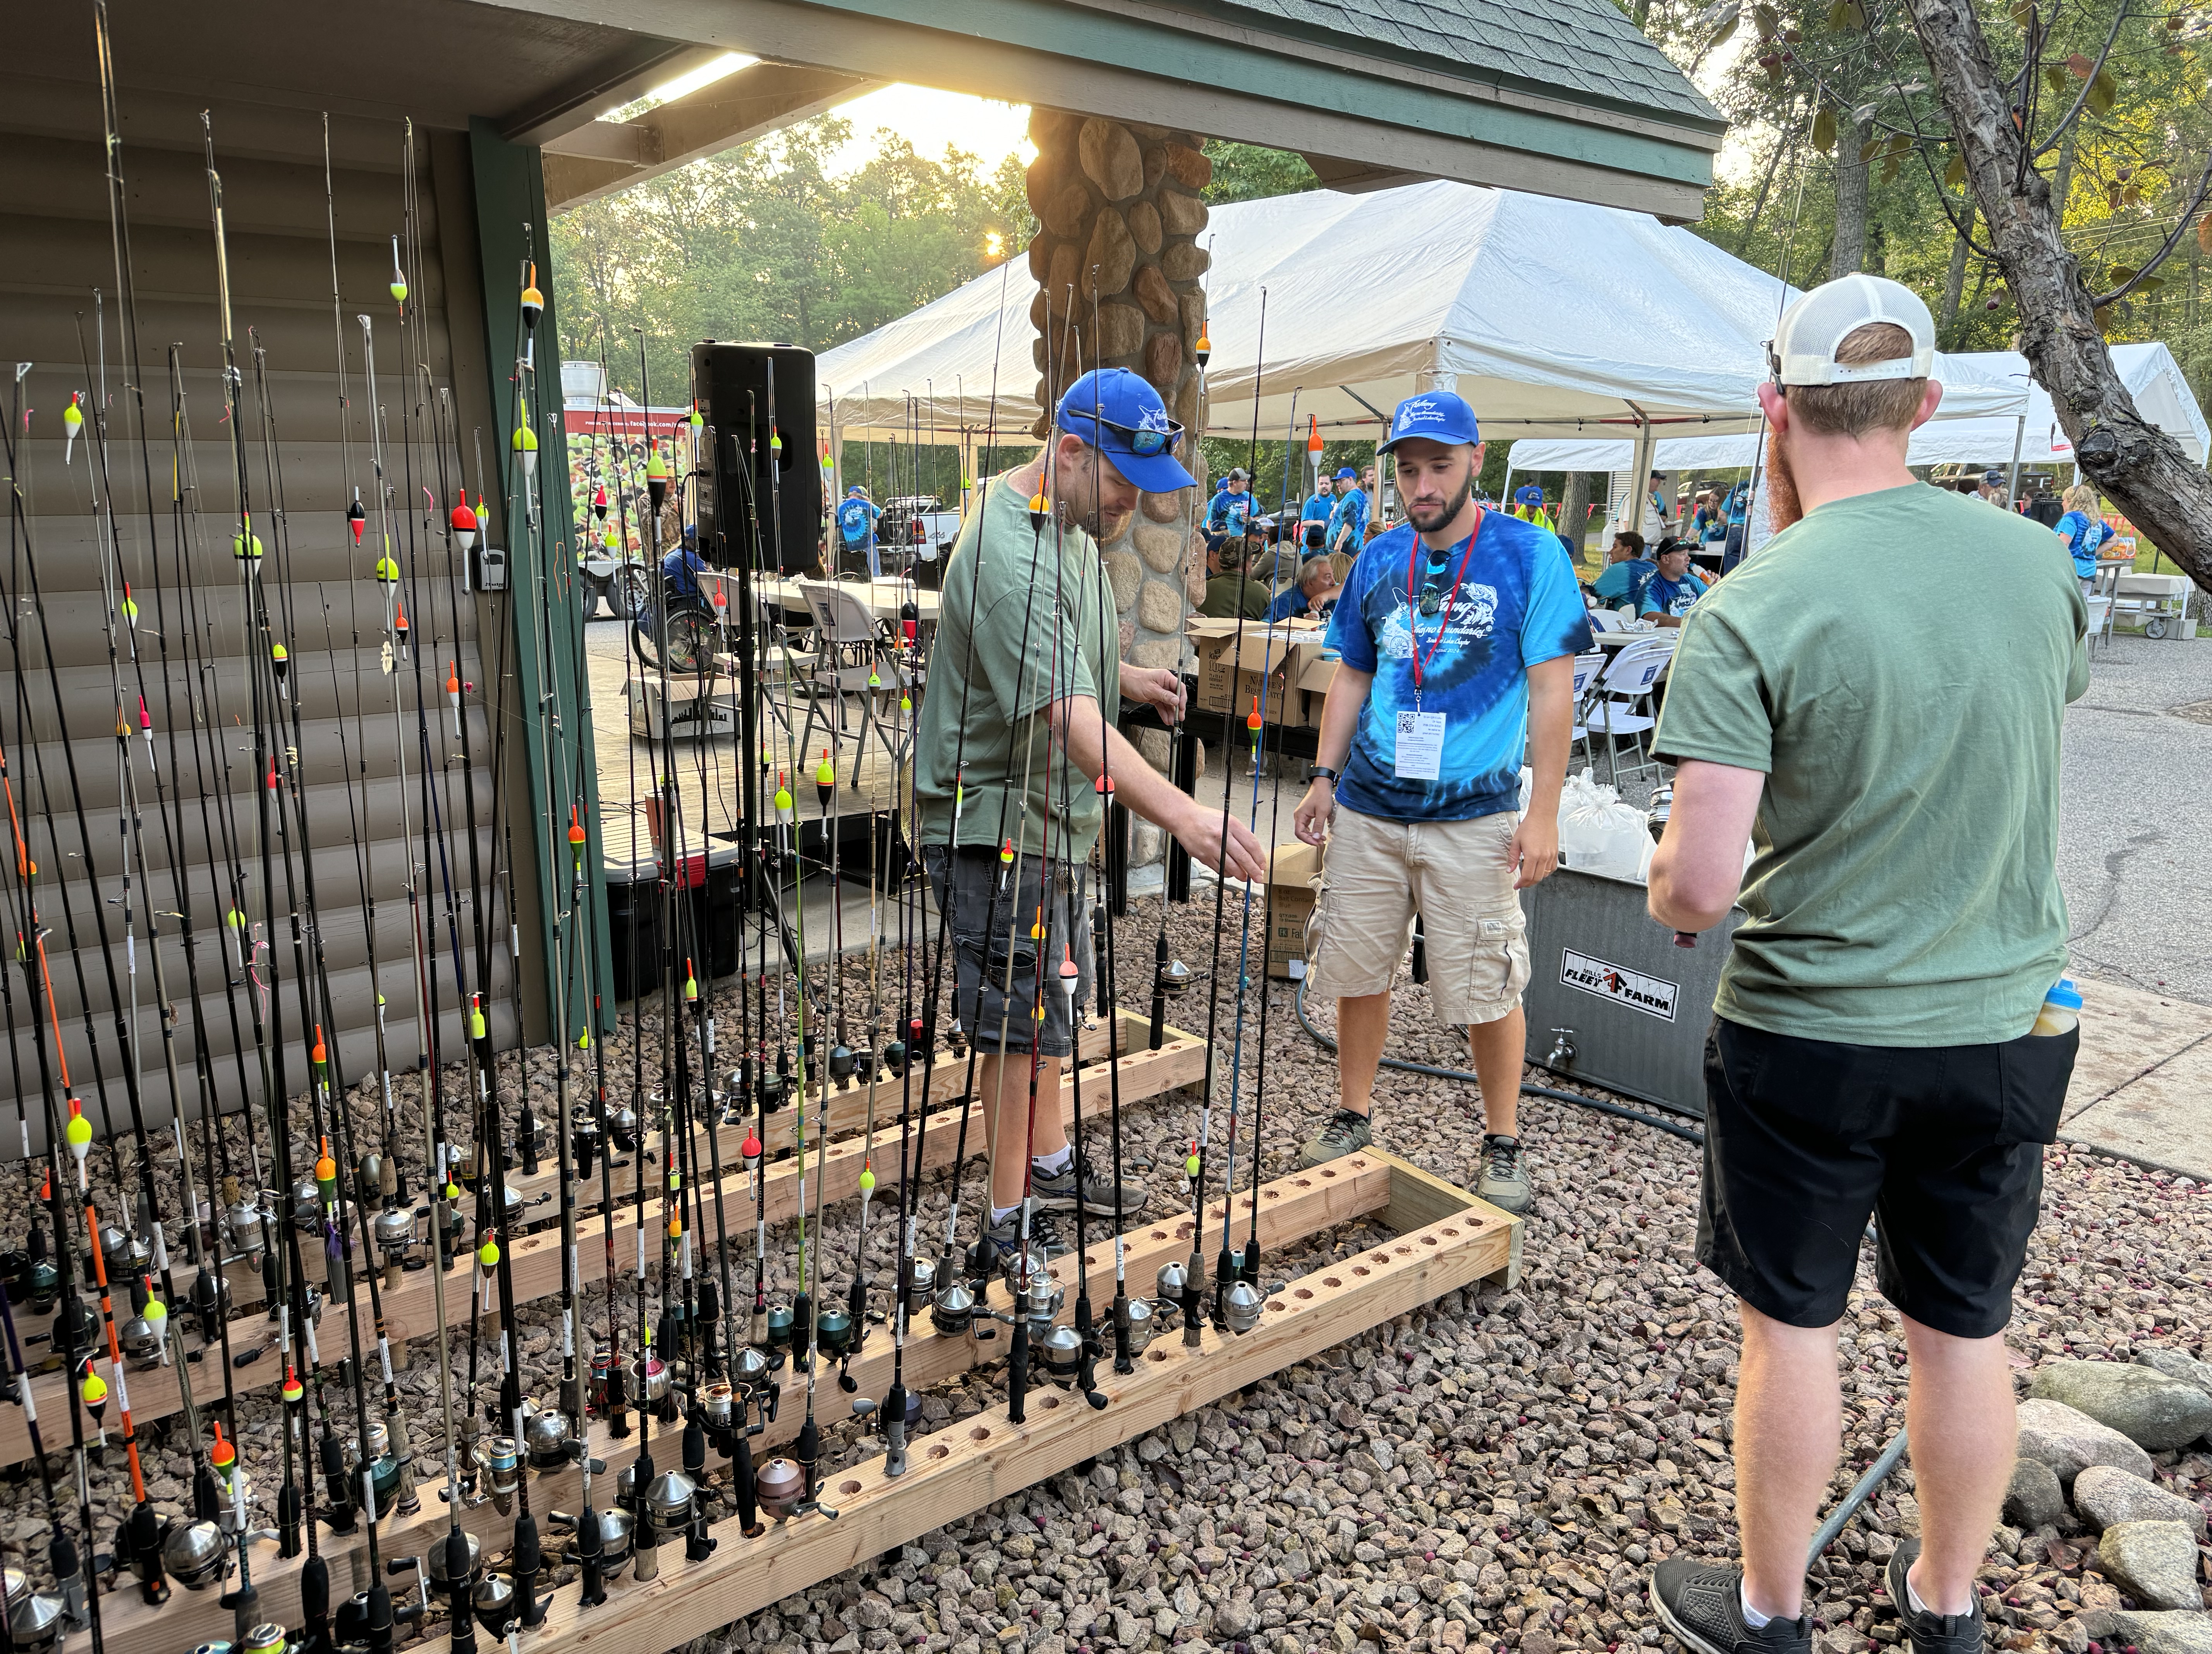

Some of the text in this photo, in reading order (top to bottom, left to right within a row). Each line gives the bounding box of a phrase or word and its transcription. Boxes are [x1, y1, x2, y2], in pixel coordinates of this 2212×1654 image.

[1437, 625, 1488, 638] bundaries
[1583, 968, 1601, 978] MILLS
[1565, 968, 1669, 1011] FLEET FARM
